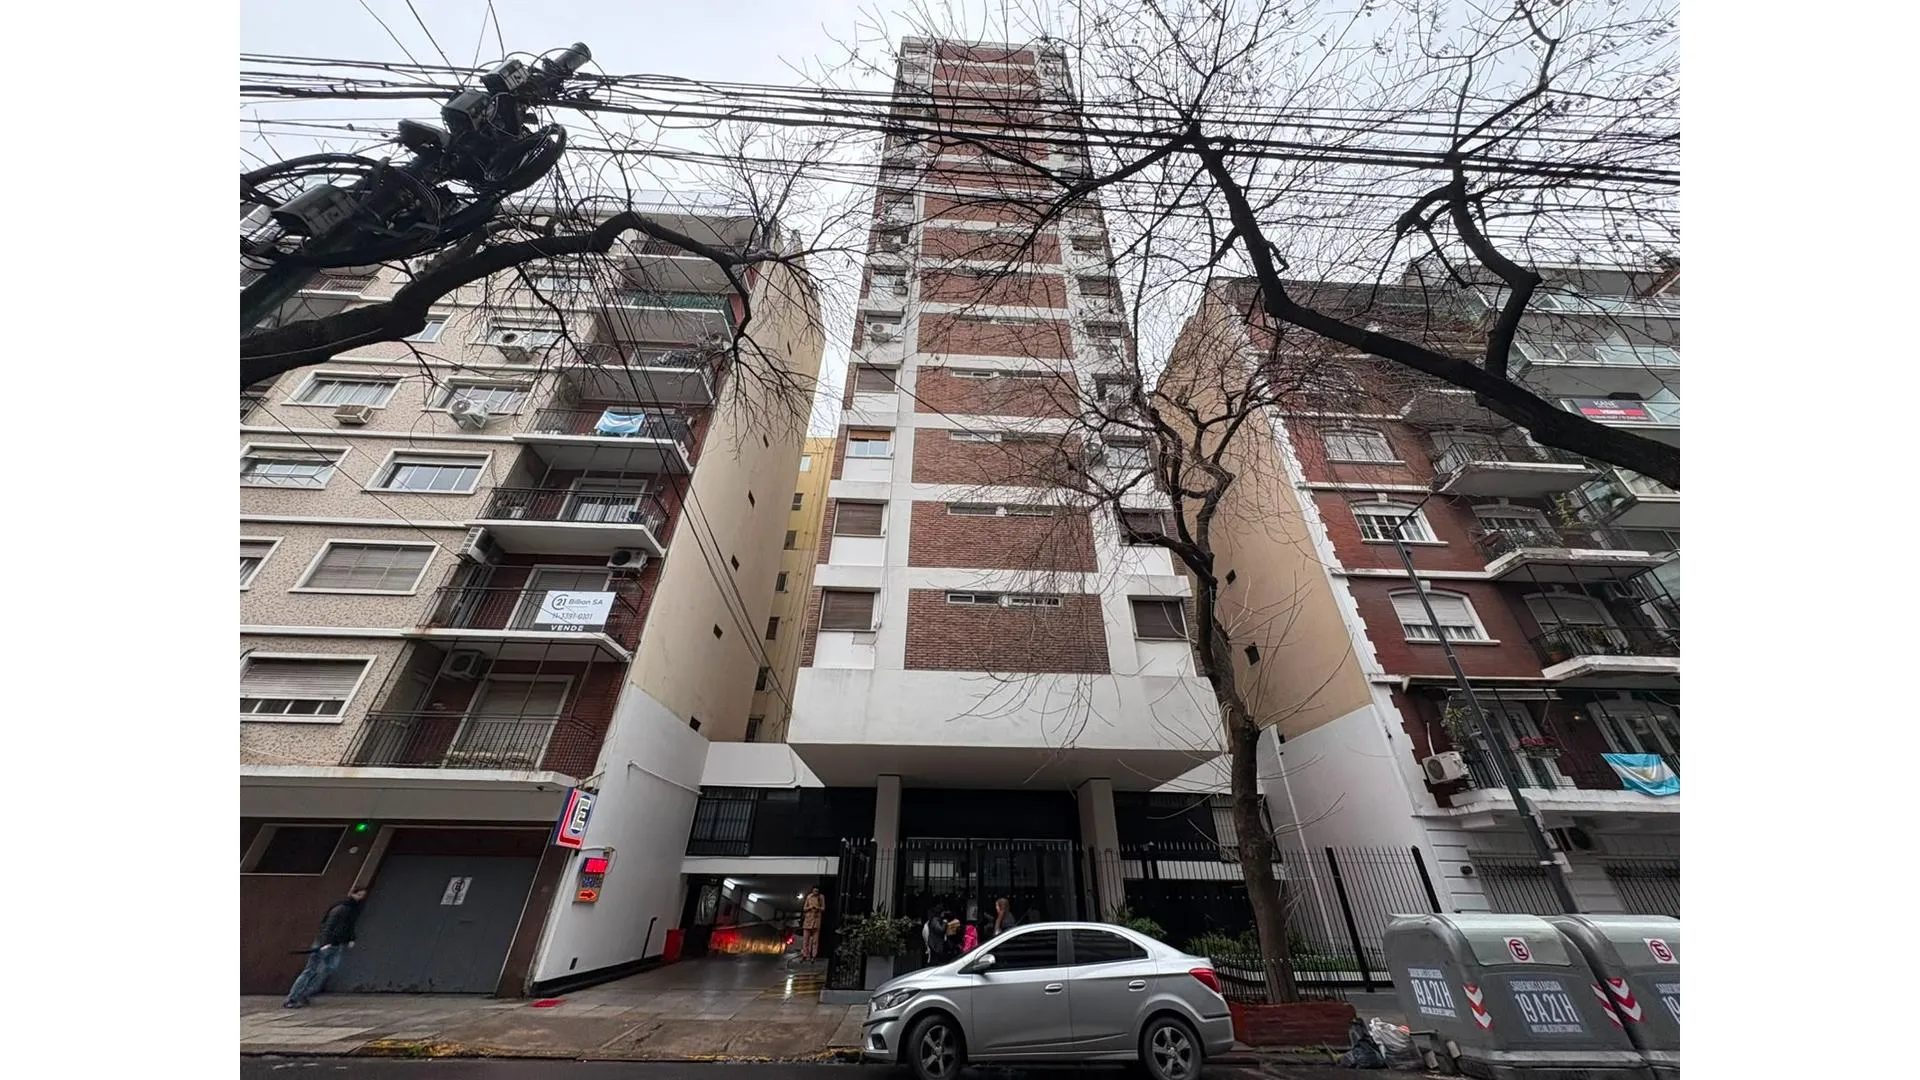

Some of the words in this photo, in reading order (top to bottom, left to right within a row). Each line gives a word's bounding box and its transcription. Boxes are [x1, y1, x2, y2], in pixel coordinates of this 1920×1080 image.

[1411, 979, 1426, 1005] 19
[1422, 980, 1435, 1006] A
[1429, 980, 1446, 1007] 21
[1439, 980, 1455, 1008] H
[1514, 993, 1538, 1023] 19
[1532, 993, 1552, 1023] A
[1542, 993, 1567, 1023] 21
[1558, 993, 1580, 1023] H
